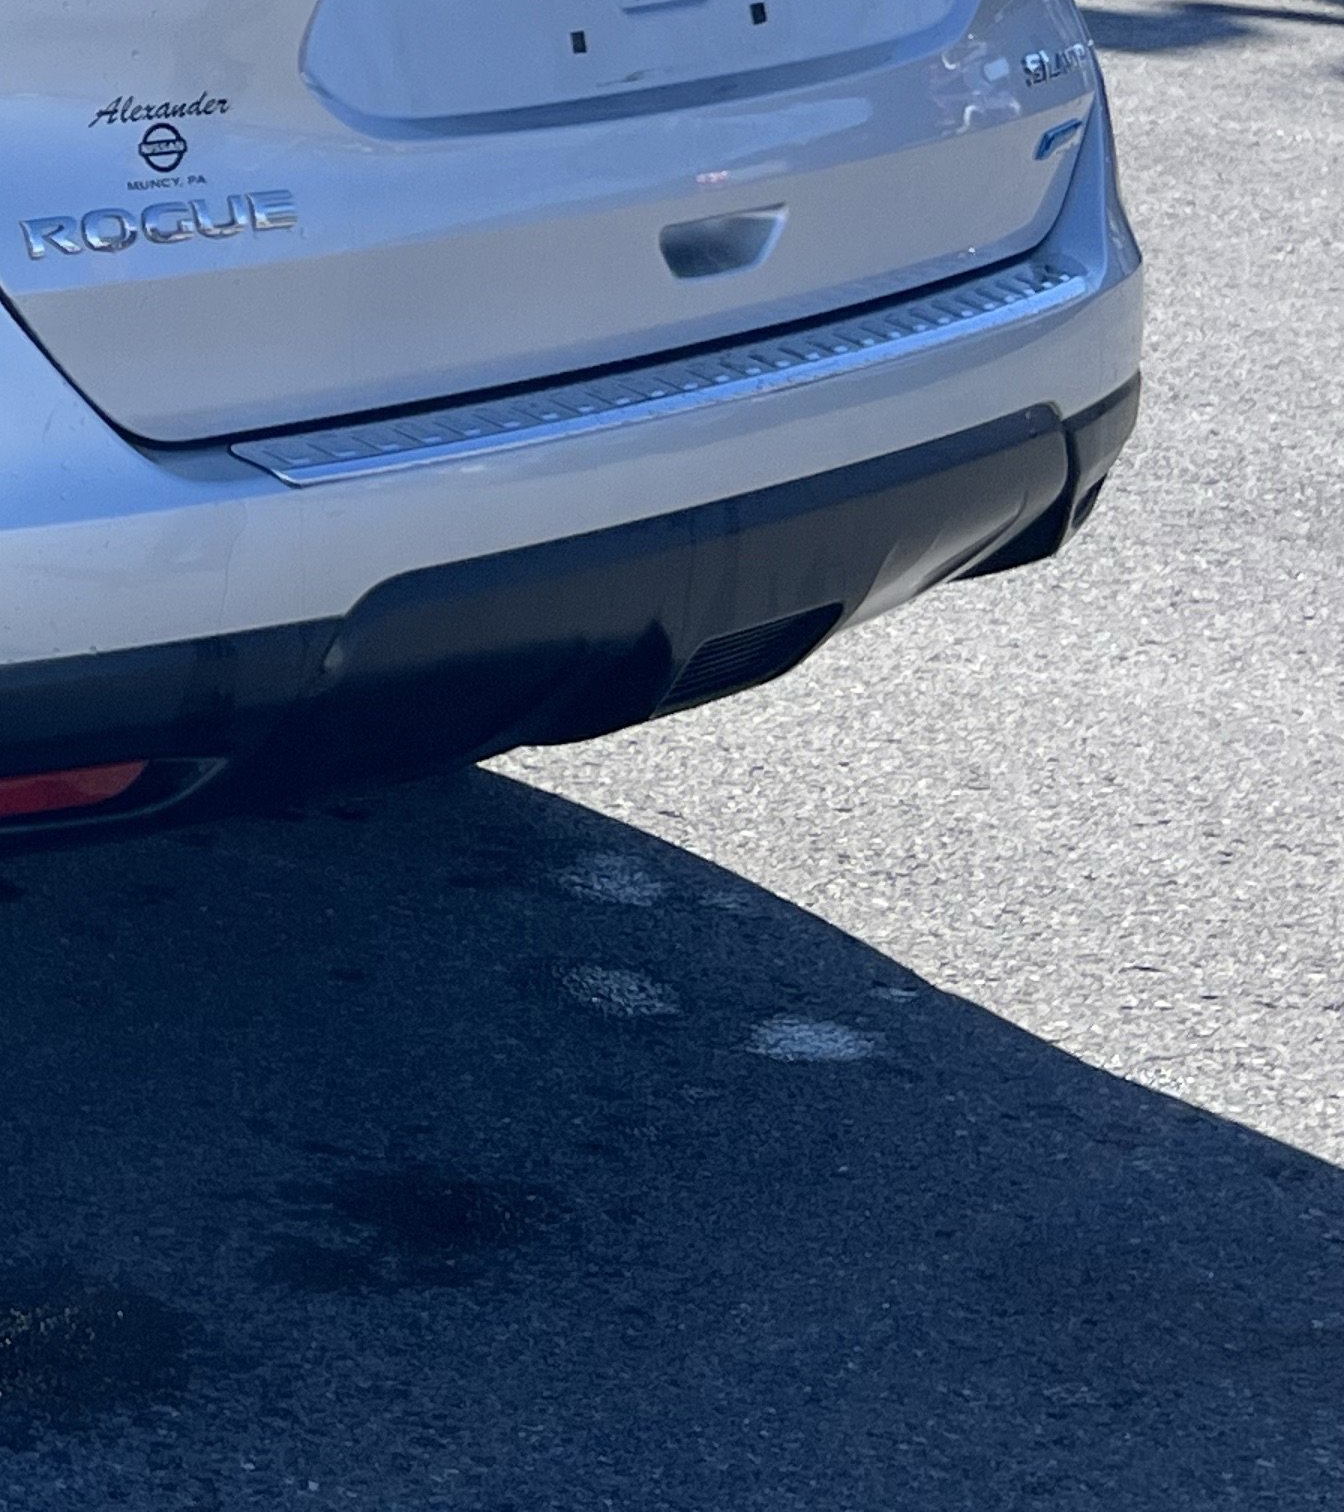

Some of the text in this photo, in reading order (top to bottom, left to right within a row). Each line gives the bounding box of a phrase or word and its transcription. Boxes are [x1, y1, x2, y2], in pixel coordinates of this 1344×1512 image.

[88, 91, 230, 128] Alexander
[187, 175, 207, 186] PA
[20, 189, 299, 261] ROGUE
